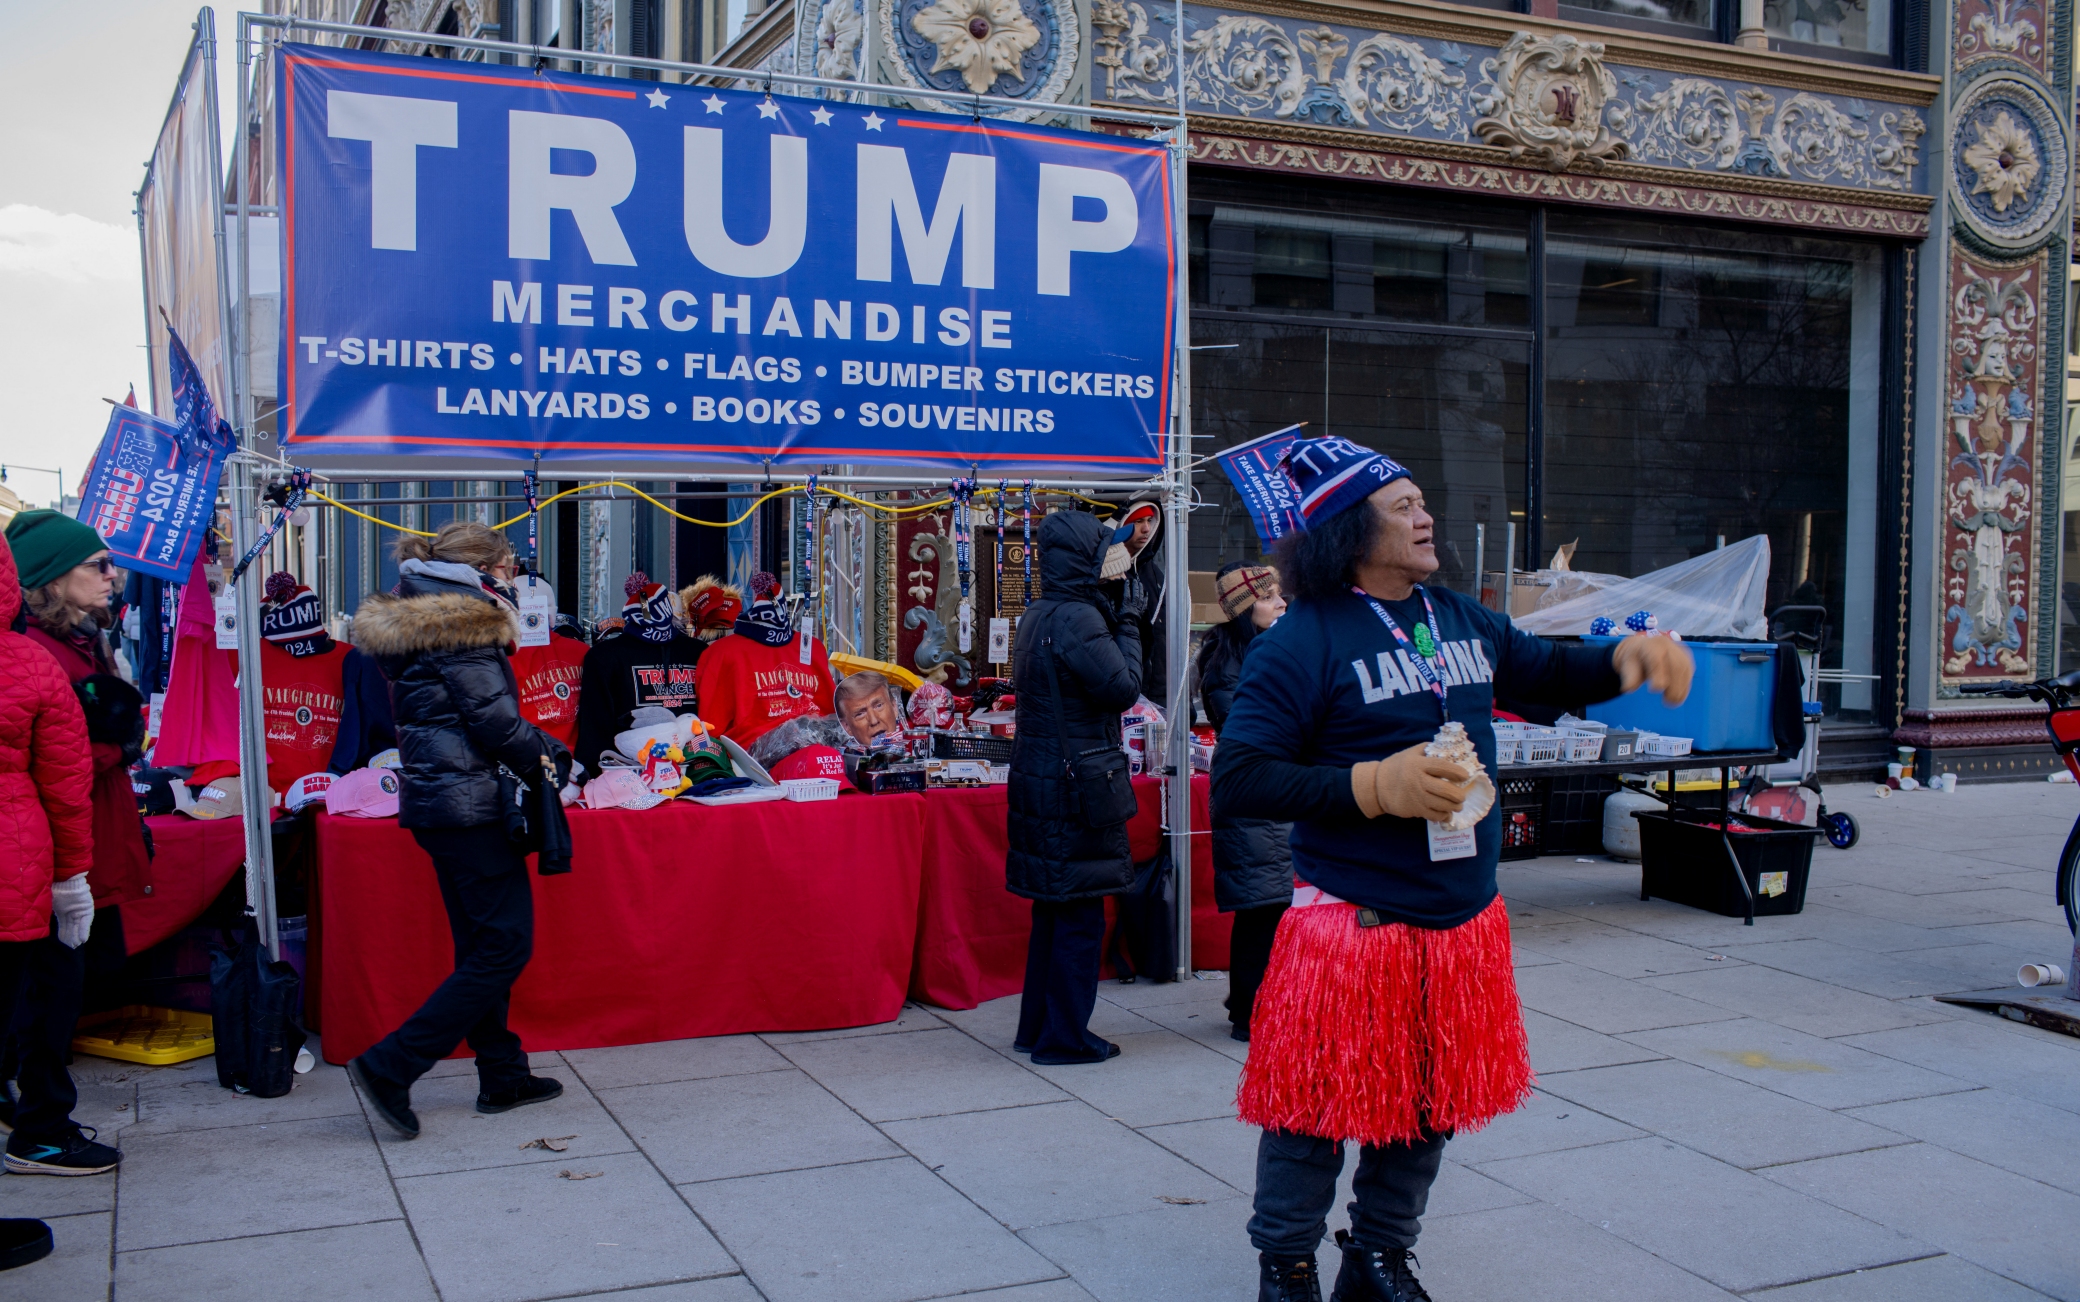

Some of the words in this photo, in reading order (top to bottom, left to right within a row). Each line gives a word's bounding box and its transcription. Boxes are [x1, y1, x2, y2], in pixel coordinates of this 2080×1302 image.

[327, 90, 1138, 296] TRUMP
[492, 280, 1012, 349] MERCHANDISE
[300, 336, 494, 371] T-SHIRTS
[539, 347, 642, 376] HATS
[685, 353, 801, 383] FLAGS
[841, 360, 984, 392] BUMPER
[995, 368, 1154, 399] STICKERS
[437, 387, 650, 420] LANYARDS
[693, 396, 821, 425] BOOKS
[858, 402, 1054, 434] SOUVENIRS
[1369, 458, 1406, 482] 20
[1238, 455, 1256, 476] TAKE
[1250, 475, 1275, 512] AMERICA
[1269, 512, 1283, 539] BACK
[1262, 471, 1294, 509] 2024
[252, 534, 269, 554] TRUMP
[691, 592, 710, 608] Trump
[1370, 601, 1395, 628] TRUMP
[1428, 614, 1440, 641] TRUMP
[1410, 653, 1435, 682] TRUMP
[652, 683, 694, 696] VANCE
[663, 699, 682, 707] 2024
[1619, 745, 1628, 754] 20
[303, 775, 332, 786] ULTRA
[890, 775, 911, 783] SAVE
